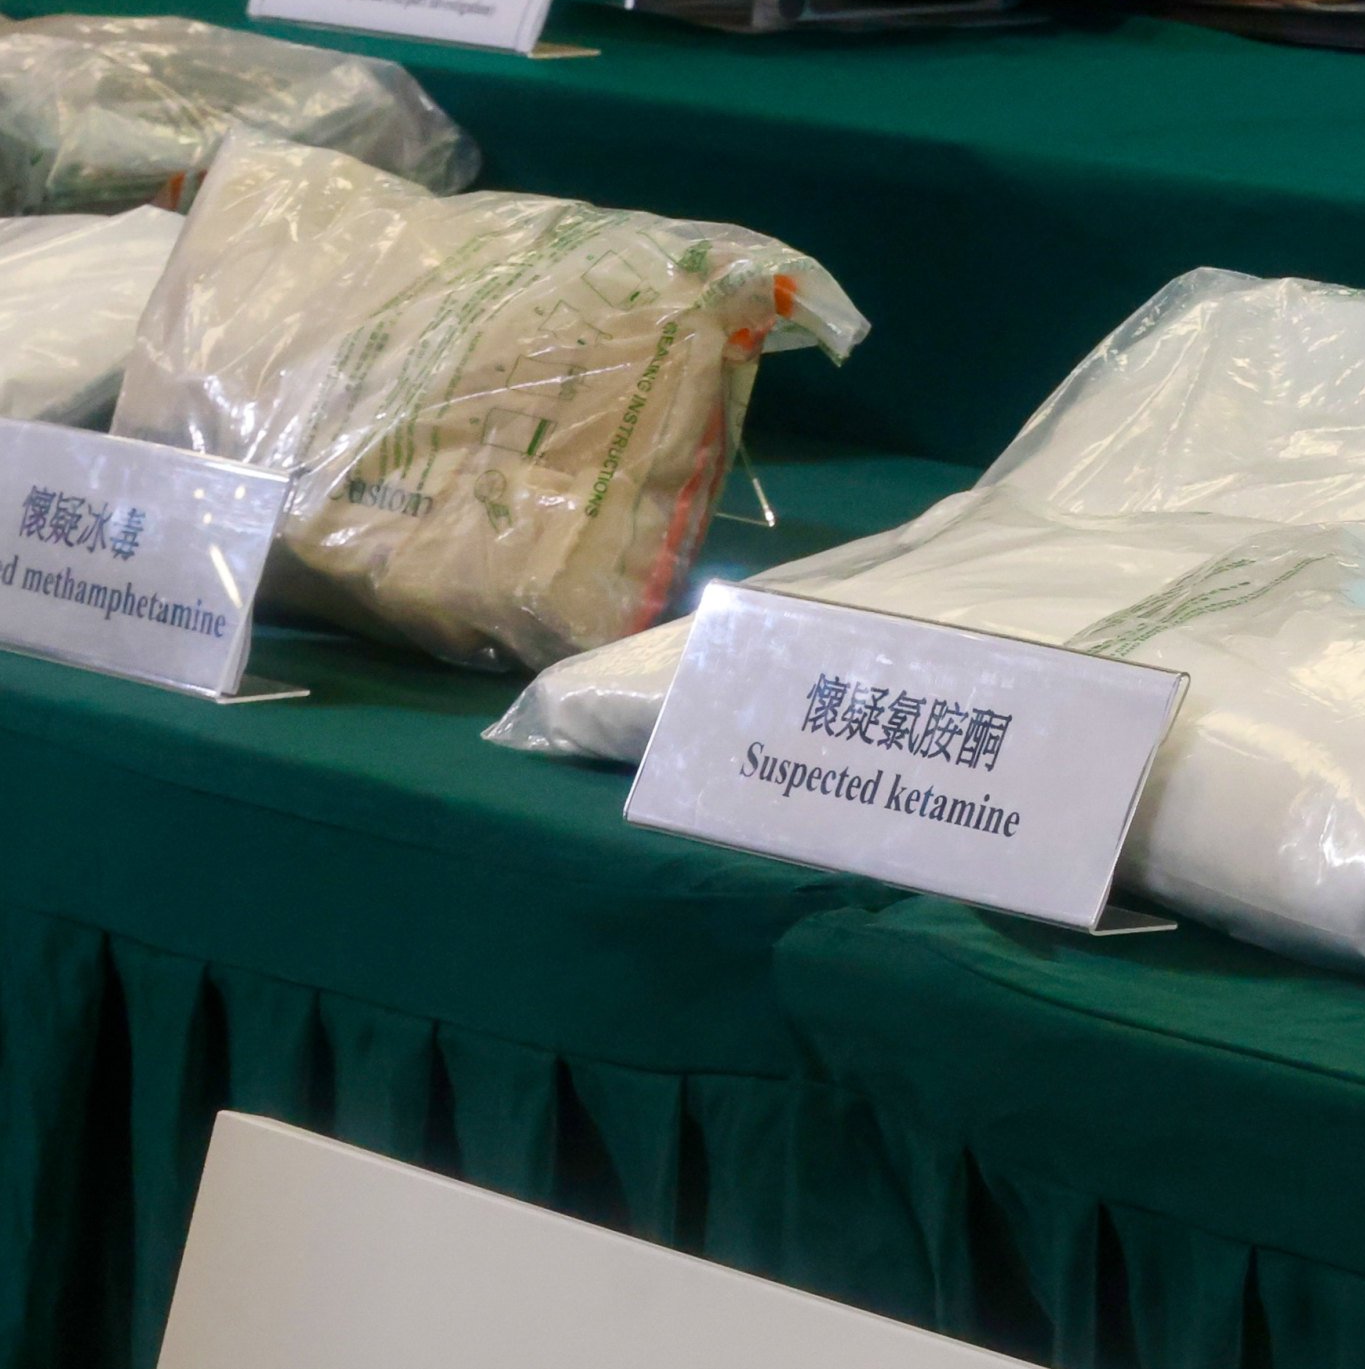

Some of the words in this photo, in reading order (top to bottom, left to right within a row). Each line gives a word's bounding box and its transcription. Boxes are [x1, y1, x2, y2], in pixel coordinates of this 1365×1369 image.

[584, 392, 649, 519] INSTRUCTIONS
[19, 484, 147, 561] 懷疑冰毒
[21, 565, 228, 640] methamphetamine
[800, 673, 1012, 773] 懷疑氯胺酮
[738, 740, 885, 807] Suspected
[885, 773, 1021, 839] ketamine
